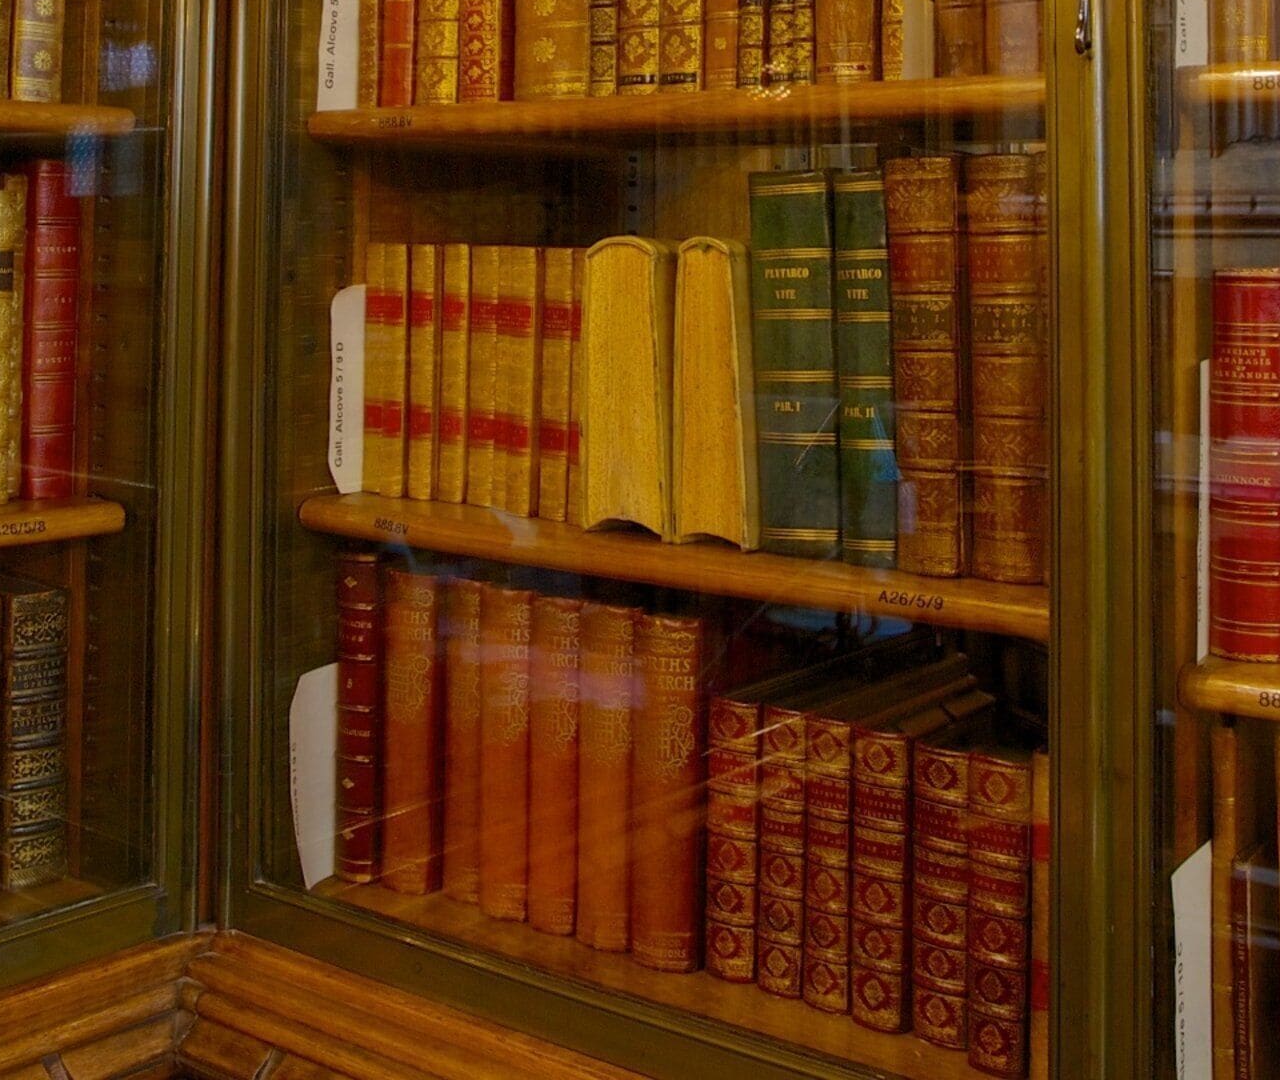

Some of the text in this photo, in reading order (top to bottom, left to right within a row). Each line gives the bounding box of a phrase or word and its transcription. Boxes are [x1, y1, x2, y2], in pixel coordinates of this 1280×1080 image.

[326, 8, 338, 56] Alcove
[325, 58, 336, 90] Gall.
[334, 387, 344, 433] Alcove
[334, 438, 344, 468] Gall.
[878, 590, 945, 611] A26/5/9
